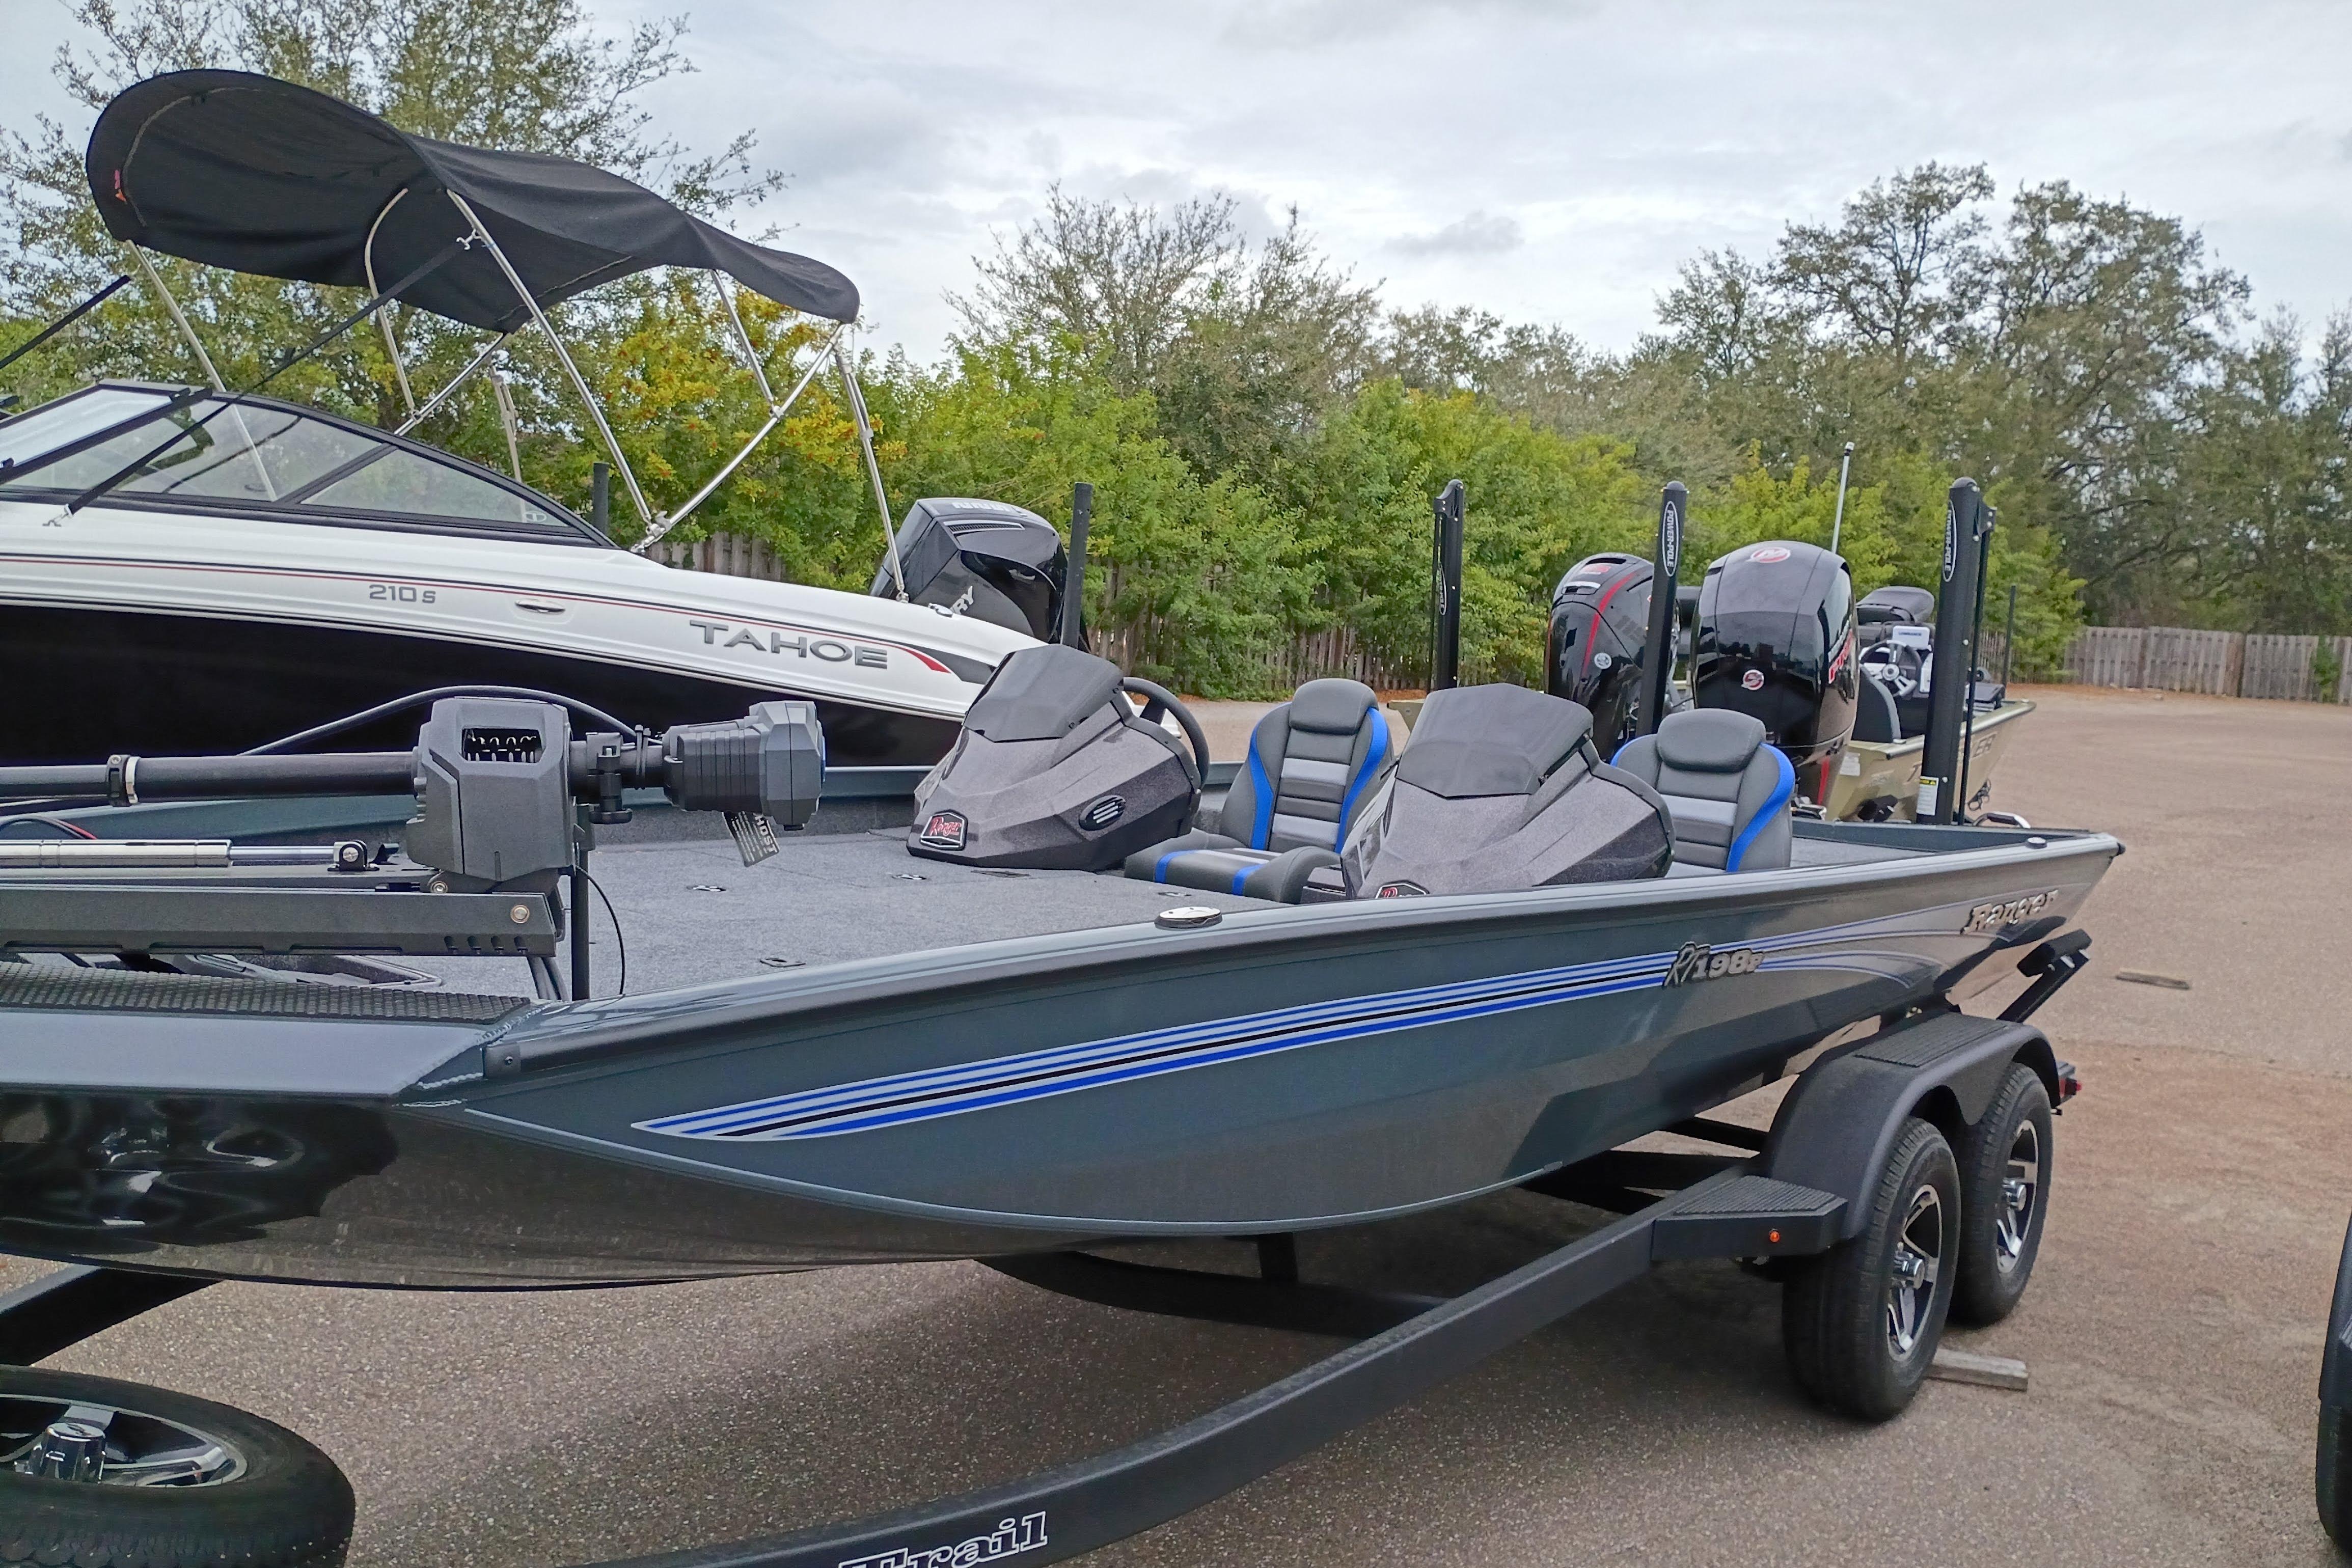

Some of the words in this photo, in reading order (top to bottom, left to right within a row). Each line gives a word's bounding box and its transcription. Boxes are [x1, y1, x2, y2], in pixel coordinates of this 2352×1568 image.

[1666, 510, 1675, 568] POWER-POLE
[369, 584, 417, 602] 210
[690, 619, 888, 670] TAHOE
[753, 813, 778, 853] HOST
[929, 816, 962, 836] Ranger
[1961, 889, 2059, 935] Ranger
